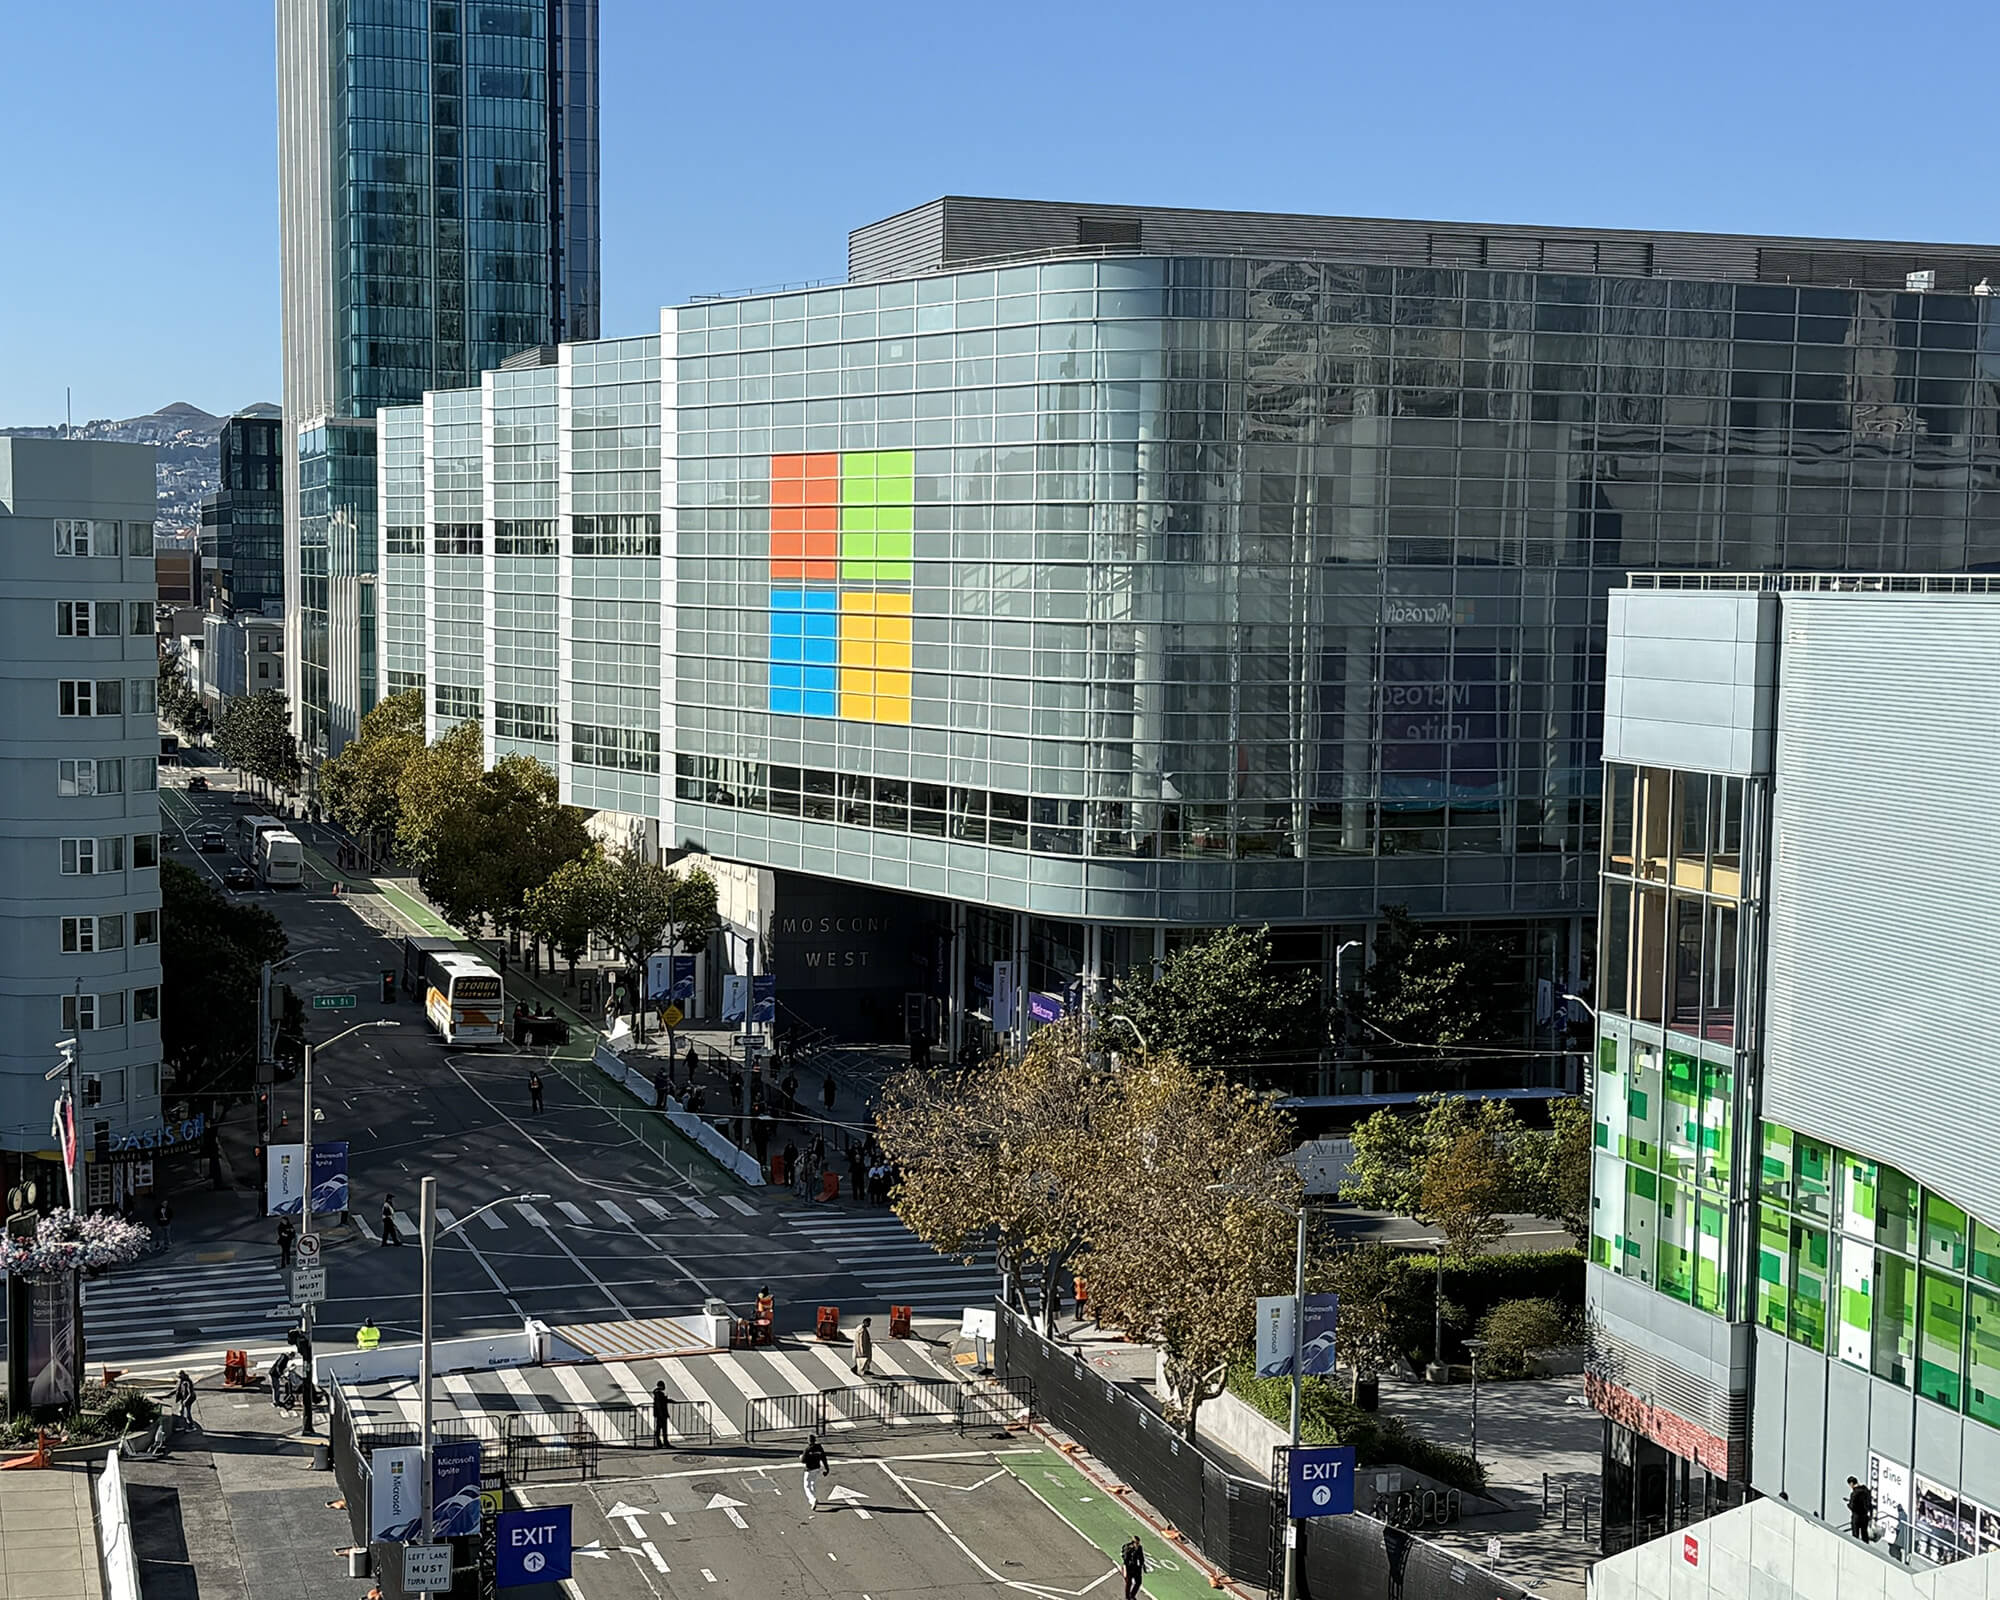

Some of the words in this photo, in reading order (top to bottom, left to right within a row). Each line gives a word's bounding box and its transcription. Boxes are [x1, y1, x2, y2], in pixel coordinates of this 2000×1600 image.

[806, 952, 869, 967] WEST
[1312, 1143, 1351, 1154] WHI
[299, 1282, 319, 1290] MUST
[438, 1456, 475, 1466] Microsoft
[438, 1467, 460, 1477] Ignite
[1303, 1462, 1342, 1480] EXIT
[393, 1476, 401, 1516] Microsoft
[1882, 1493, 1898, 1509] sho
[511, 1525, 557, 1547] EXIT
[408, 1552, 424, 1561] LEFT
[429, 1552, 448, 1560] LANE
[412, 1564, 443, 1573] MUST
[407, 1577, 427, 1586] TURN
[430, 1576, 447, 1585] LEFT
